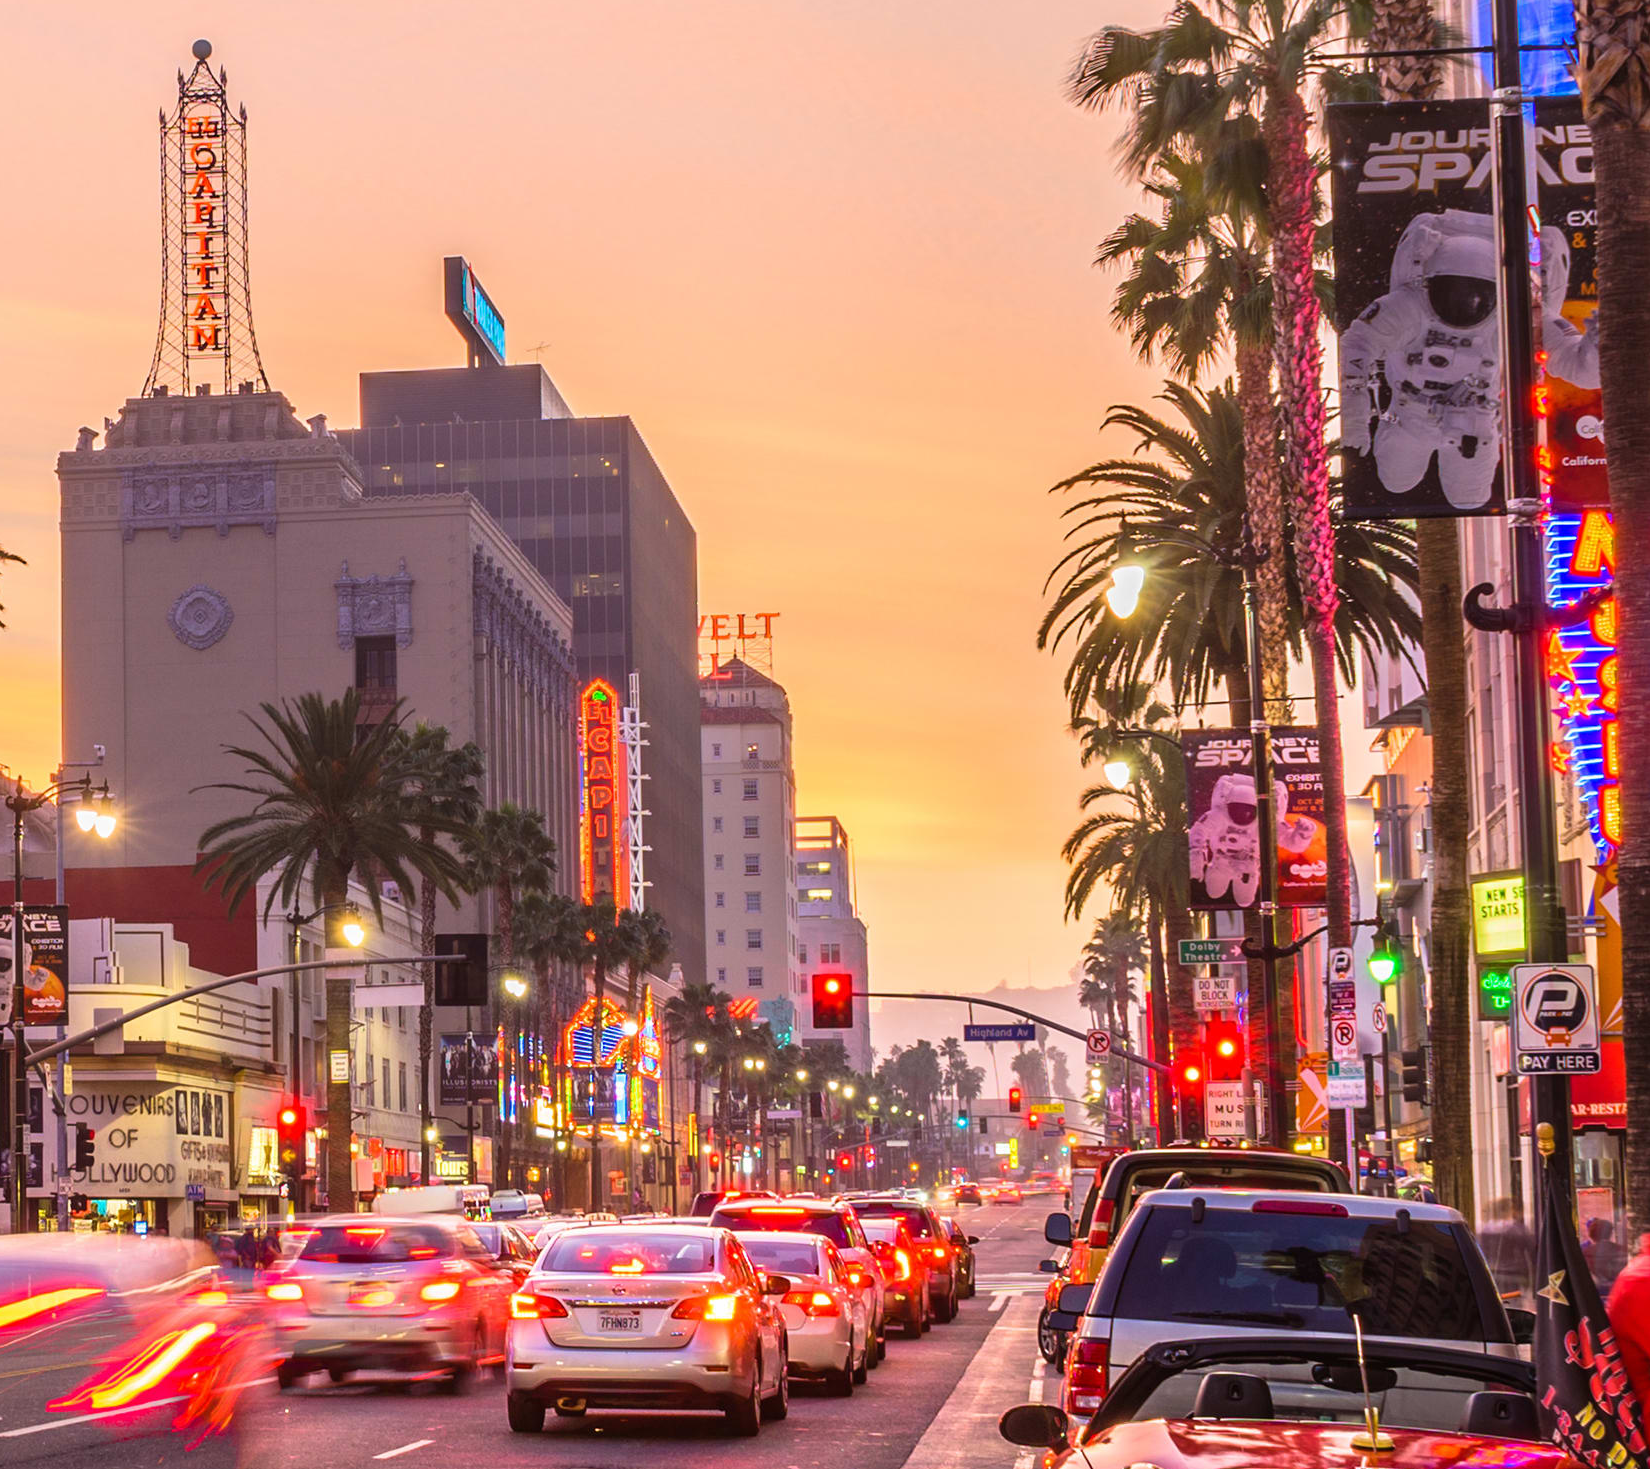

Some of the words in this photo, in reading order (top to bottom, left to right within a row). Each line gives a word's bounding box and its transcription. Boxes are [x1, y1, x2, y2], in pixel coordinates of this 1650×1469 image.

[1368, 125, 1592, 152] JOURNE
[187, 141, 222, 352] CAPITAN
[1562, 455, 1607, 467] Californ
[586, 699, 613, 727] EL
[1285, 773, 1322, 783] EXHIBIT
[1297, 782, 1313, 791] 3D
[586, 728, 616, 895] CAPITA
[1486, 889, 1507, 902] NEW
[1481, 903, 1520, 919] STARTS
[1189, 942, 1221, 953] Dolby
[1184, 952, 1228, 962] Theatre
[1198, 980, 1211, 990] DO
[1213, 980, 1230, 989] NOT
[1200, 990, 1229, 1000] BLOCK
[970, 1028, 1013, 1040] Highland
[1016, 1028, 1029, 1037] Av
[1522, 1056, 1550, 1070] PAY
[1556, 1055, 1595, 1069] HERE
[1208, 1090, 1234, 1099] RIGHT
[69, 1094, 175, 1116] OUVENIRS
[1215, 1105, 1244, 1114] MUS
[1210, 1120, 1232, 1128] TURN
[108, 1128, 139, 1149] OF
[435, 1163, 469, 1177] Tours
[186, 1185, 205, 1195] ATM
[599, 1316, 640, 1329] 7FHN873
[1574, 1401, 1606, 1441] NO
